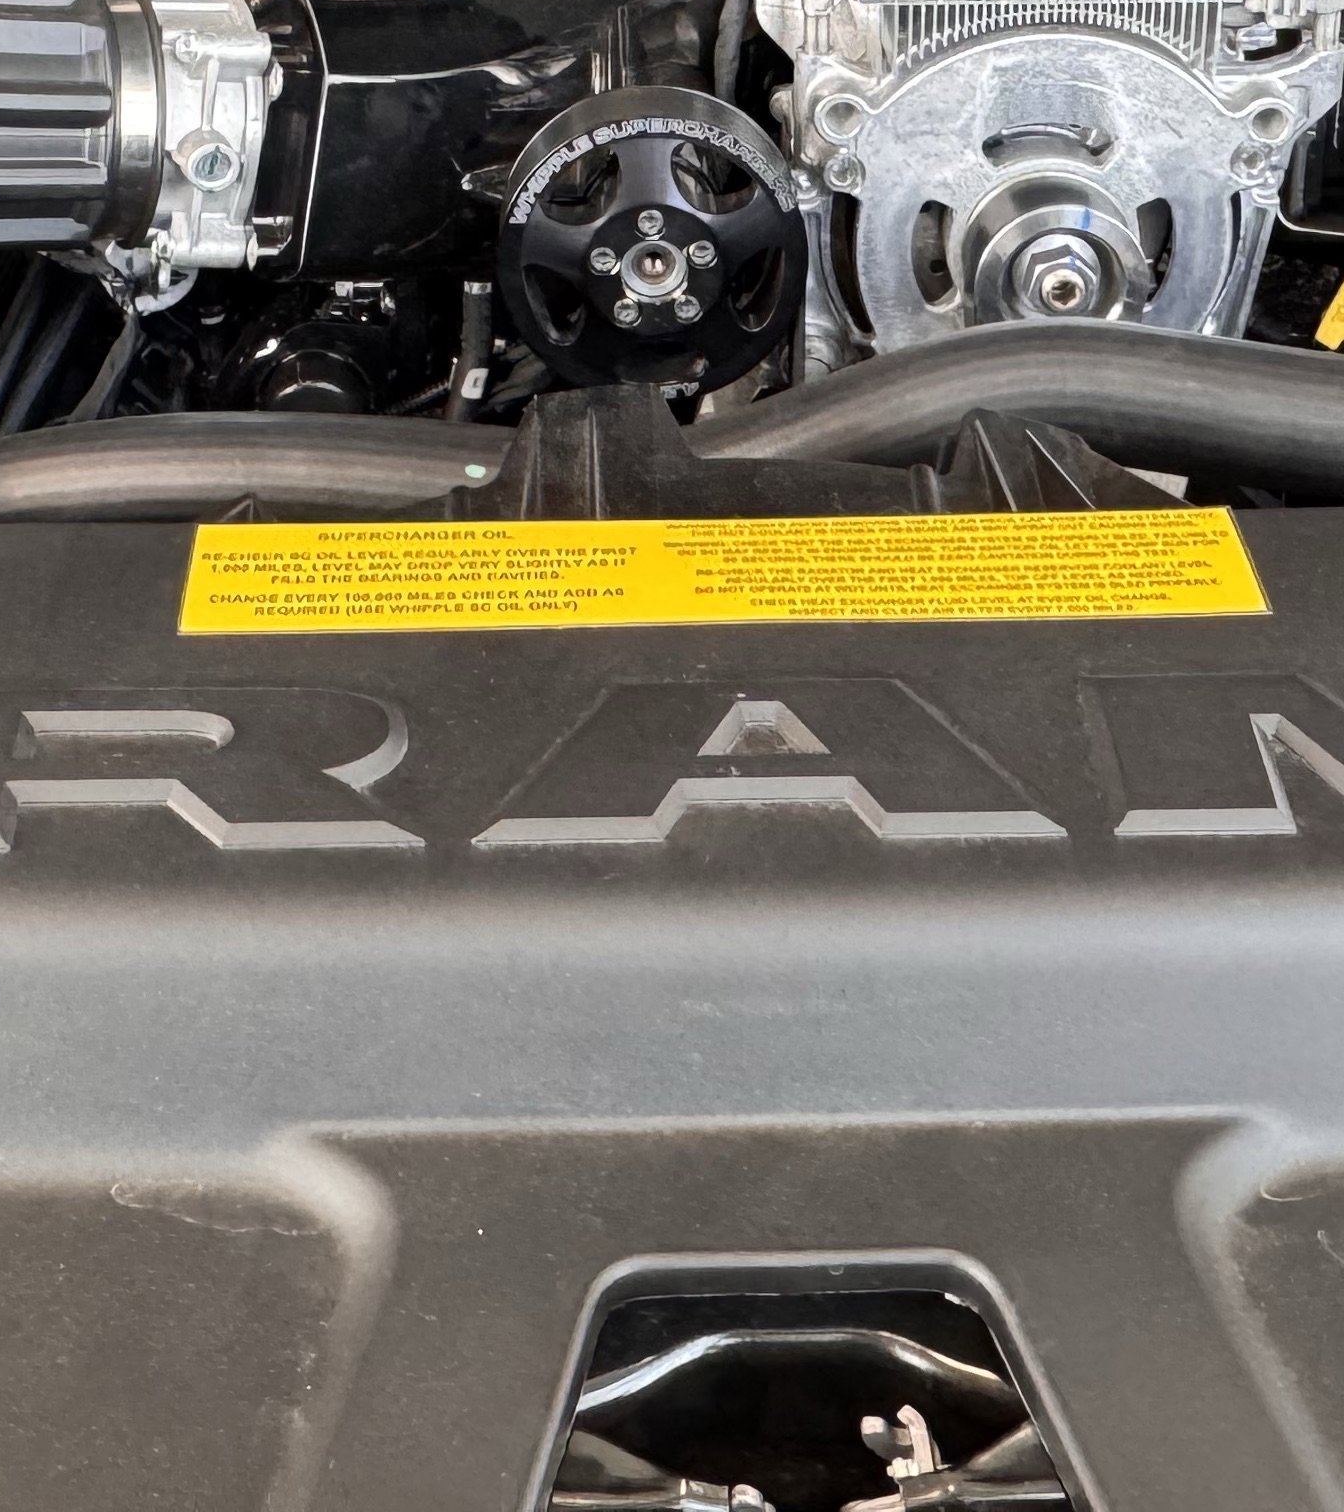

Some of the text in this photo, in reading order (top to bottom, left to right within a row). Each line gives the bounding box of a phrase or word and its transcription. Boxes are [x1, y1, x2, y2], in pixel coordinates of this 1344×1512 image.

[509, 118, 796, 224] WHIPPLE SUPERCHARGERS
[318, 530, 514, 541] SUPERCHARGER OIL
[315, 550, 343, 560] OIL
[346, 549, 399, 560] LEVEL
[402, 548, 502, 559] REGULARLY
[505, 548, 551, 558] OVER
[554, 547, 588, 557] THE
[591, 547, 638, 557] FIRST
[311, 562, 364, 572] LEVEL
[367, 561, 402, 571] MAY
[406, 560, 454, 571] DROP
[457, 560, 501, 570] VERY
[504, 558, 584, 569] SLIGHTLY
[586, 558, 609, 568] AS
[612, 558, 626, 568] IT
[270, 574, 316, 584] FILLS
[321, 574, 353, 584] THE
[357, 573, 443, 583] BEARINGS
[447, 572, 483, 582] AND
[208, 593, 280, 603] CHANGE
[283, 592, 339, 602] EVERY
[460, 590, 520, 600] CHECK
[523, 589, 560, 599] AND
[562, 588, 599, 599] ADD
[602, 588, 625, 598] AS
[254, 605, 341, 616] REQUIRED
[345, 604, 386, 615] (USE
[389, 603, 465, 614] WHIPPLE
[496, 602, 525, 612] OIL
[527, 602, 579, 612] ONLY)
